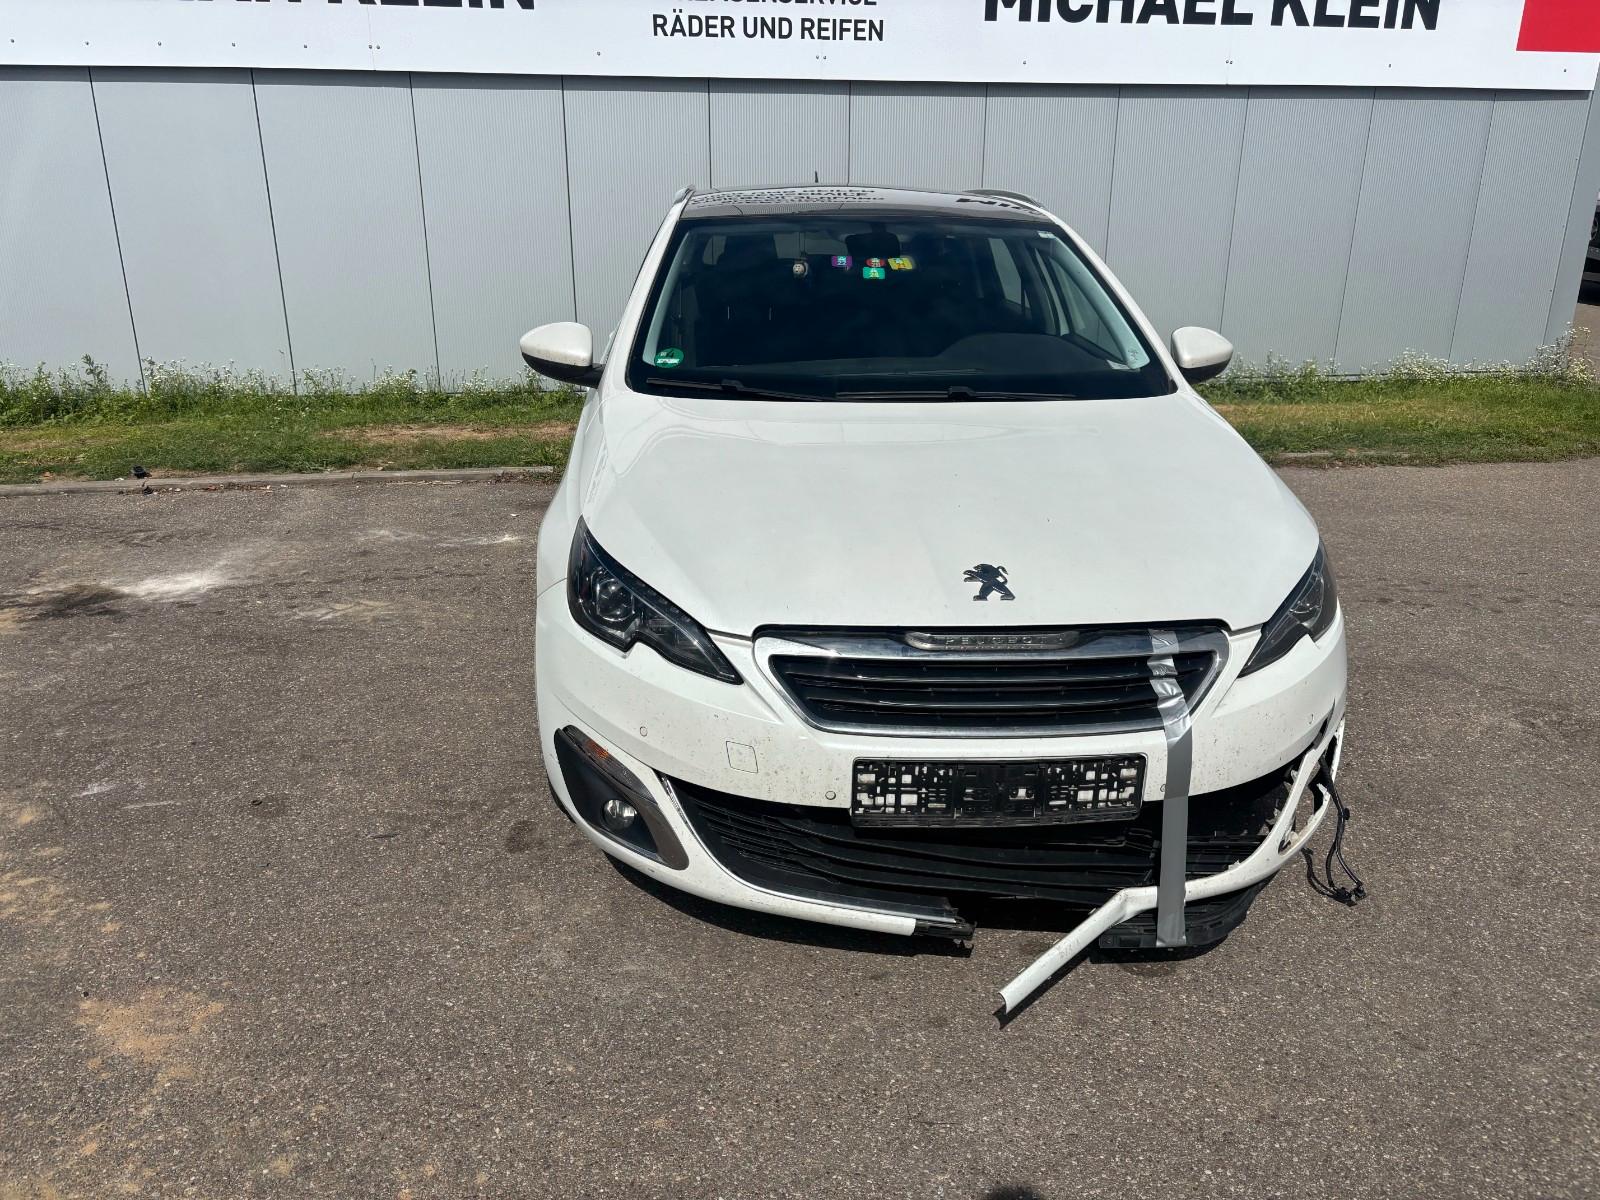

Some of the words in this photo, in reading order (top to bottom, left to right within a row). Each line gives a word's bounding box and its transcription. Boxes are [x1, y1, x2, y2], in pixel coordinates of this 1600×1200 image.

[652, 9, 736, 38] RÄDER
[743, 16, 793, 39] UND
[801, 17, 884, 41] REIFEN
